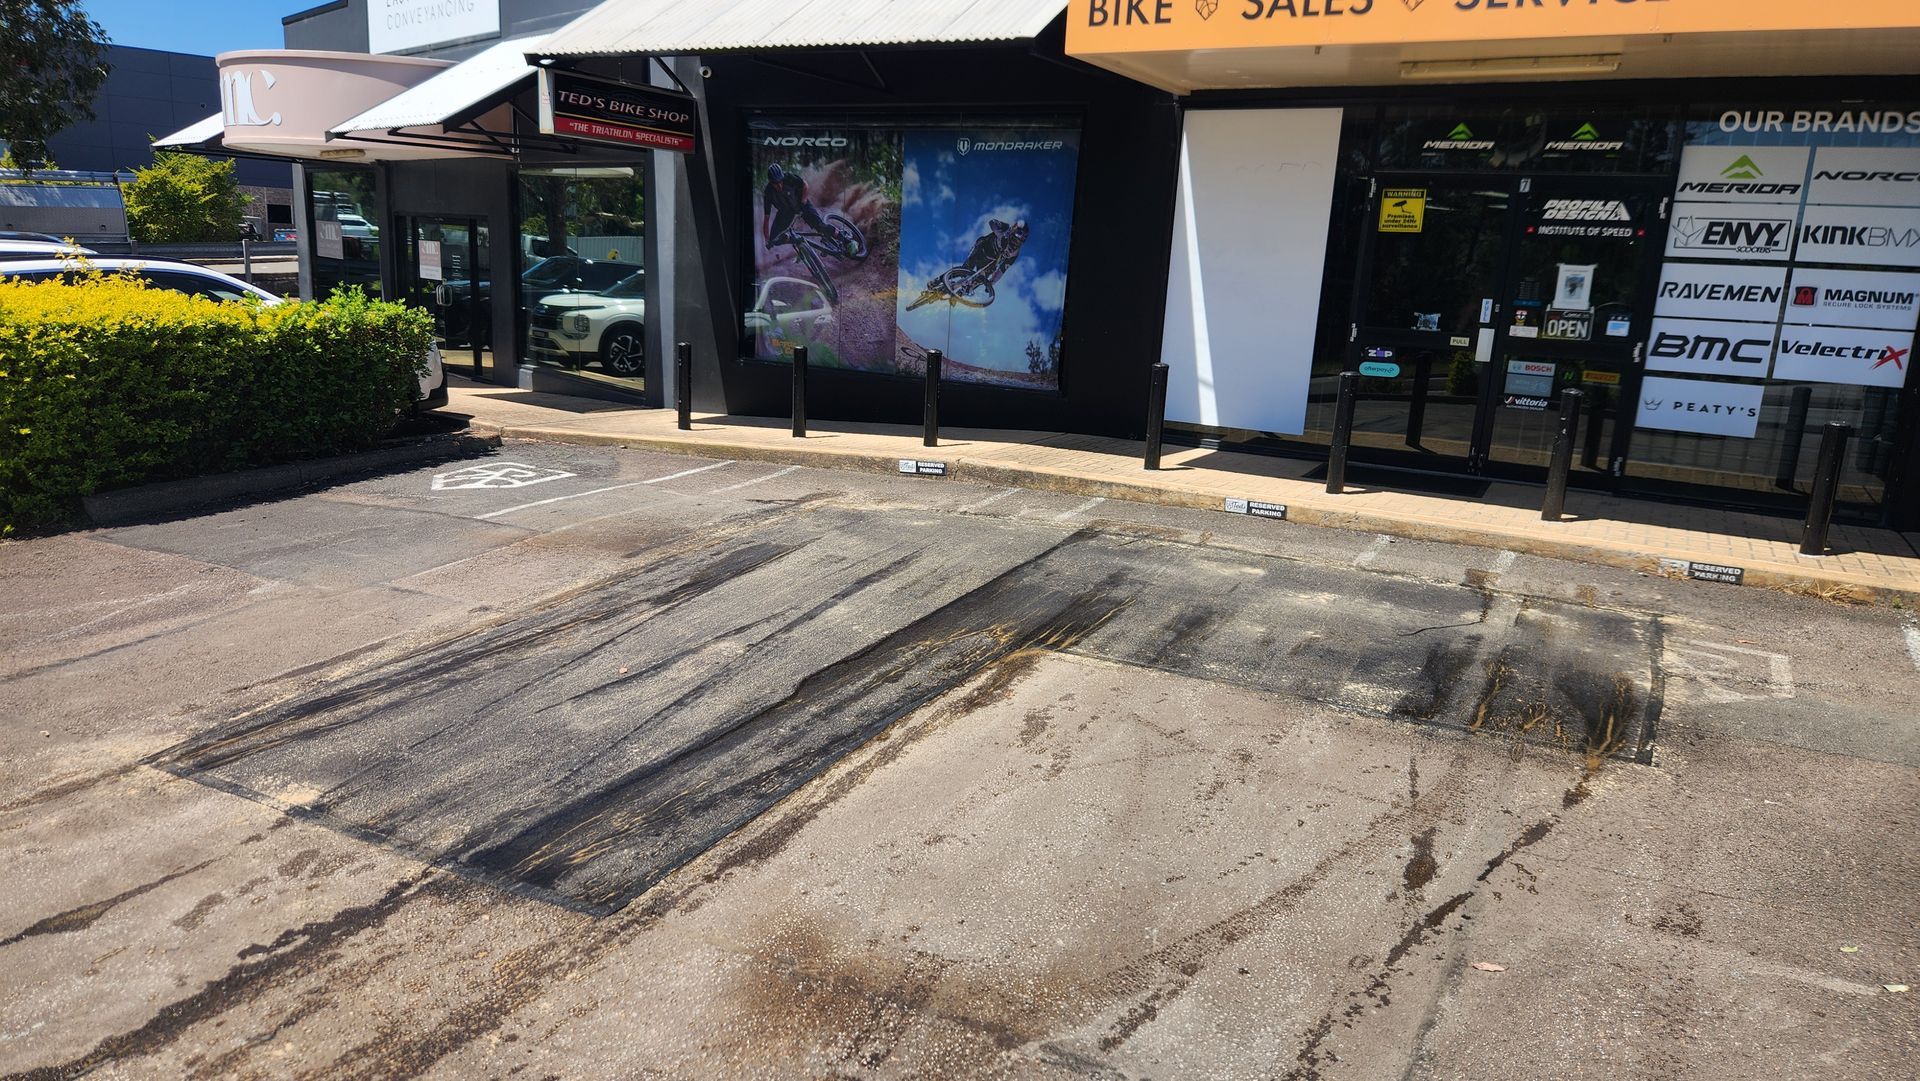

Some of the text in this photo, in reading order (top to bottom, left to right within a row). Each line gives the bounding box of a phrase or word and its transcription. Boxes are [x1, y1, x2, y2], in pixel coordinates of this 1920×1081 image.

[387, 2, 474, 30] CONVEYANCING
[1088, 0, 1173, 27] BIKE
[558, 90, 605, 109] TED'S
[609, 100, 645, 116] BIKE
[648, 107, 689, 123] SHOP
[1719, 110, 1920, 133] OUR BRANDS
[592, 125, 633, 139] TRIATHLON
[763, 137, 847, 147] NORCO
[973, 141, 1063, 151] MONDRAKER
[1422, 141, 1495, 150] MERIDA
[1544, 141, 1624, 150] MERIDA
[1813, 171, 1920, 181] NORC
[1678, 182, 1802, 195] MERIDA
[1543, 199, 1620, 211] PROFILE
[1538, 225, 1633, 237] INSTITUTE OF SPEED
[1660, 281, 1781, 303] RAVEMEN
[1824, 288, 1915, 305] MAGNUM
[1823, 300, 1851, 308] SECURE
[1547, 319, 1589, 338] OPEN
[1649, 331, 1771, 364] BMC
[1524, 364, 1552, 373] BOSCH
[1515, 397, 1548, 408] vittoria
[1673, 401, 1756, 417] PEATY'S
[1249, 502, 1286, 511] RESERVED
[1251, 509, 1282, 517] PARKING
[1692, 563, 1741, 575] RESERVED
